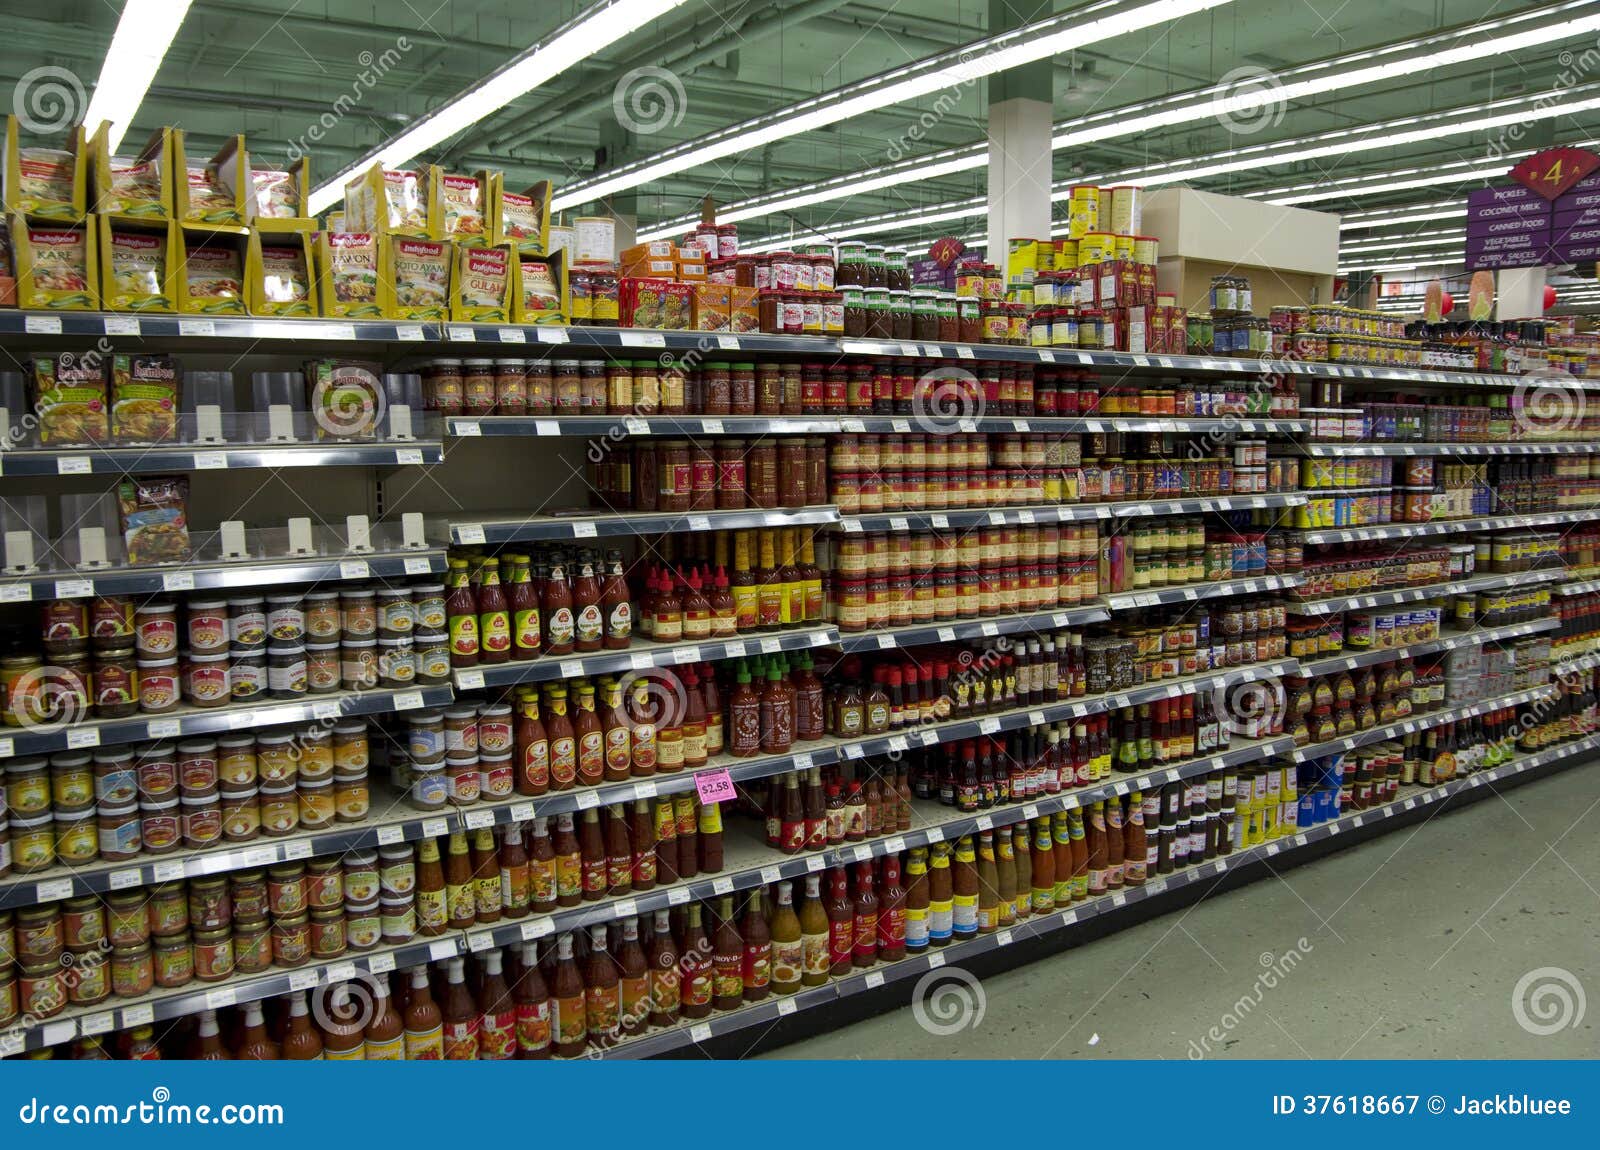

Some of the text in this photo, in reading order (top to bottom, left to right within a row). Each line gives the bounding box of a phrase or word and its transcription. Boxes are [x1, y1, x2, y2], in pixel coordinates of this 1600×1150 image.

[1543, 159, 1563, 186] 4
[1494, 189, 1527, 200] PICKLES
[1519, 202, 1541, 212] MILK
[1489, 219, 1545, 232] CANNED FOOD
[404, 244, 440, 255] Indofood
[1507, 250, 1536, 260] SAUCES
[37, 250, 73, 261] KARE
[472, 263, 504, 274] Indofood
[701, 780, 729, 795] $2.58
